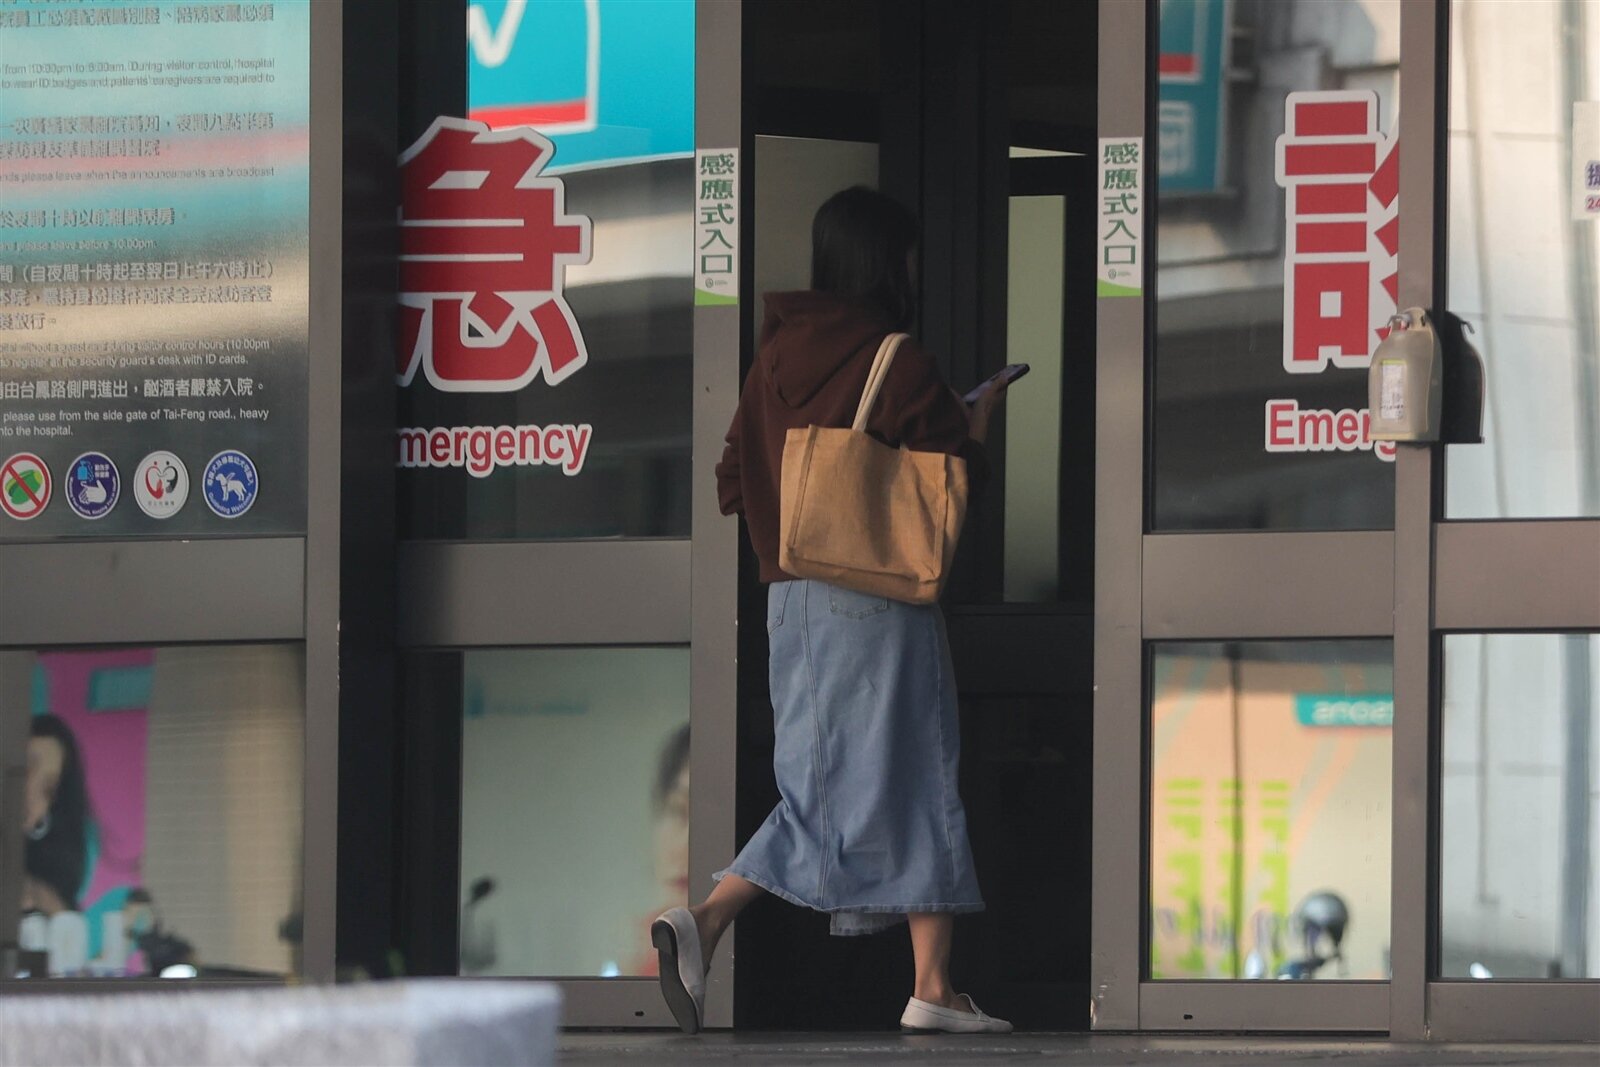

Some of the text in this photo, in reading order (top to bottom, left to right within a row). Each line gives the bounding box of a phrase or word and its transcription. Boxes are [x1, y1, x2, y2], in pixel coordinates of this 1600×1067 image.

[76, 63, 85, 73] to
[130, 60, 162, 73] During
[166, 60, 195, 71] visitor
[198, 58, 233, 71] control,
[236, 58, 275, 70] hospital
[39, 78, 50, 88] ID
[52, 77, 88, 90] badges
[154, 75, 203, 88] caregivers
[224, 73, 263, 86] required
[265, 73, 275, 83] to
[227, 167, 274, 178] broadcast
[1102, 142, 1138, 265] 感應式入口
[700, 153, 735, 274] 感應式入口
[398, 120, 588, 384] 急
[166, 340, 196, 351] control
[199, 339, 224, 350] hours
[80, 356, 117, 368] security
[158, 354, 181, 365] desk
[184, 353, 203, 364] with
[206, 353, 217, 364] ID
[219, 352, 248, 364] cards.
[0, 377, 264, 399] 由台鳳路側門進出，酗酒者嚴禁入院。
[4, 411, 35, 423] please
[39, 413, 56, 421] use
[59, 410, 81, 421] from
[84, 410, 100, 420] the
[103, 410, 123, 420] side
[126, 410, 148, 421] gate
[150, 409, 161, 419] of
[163, 408, 206, 422] Tai-Feng
[239, 408, 269, 420] heavy
[16, 426, 31, 436] the
[33, 425, 73, 437] hospital.
[1267, 402, 1397, 456] Emer
